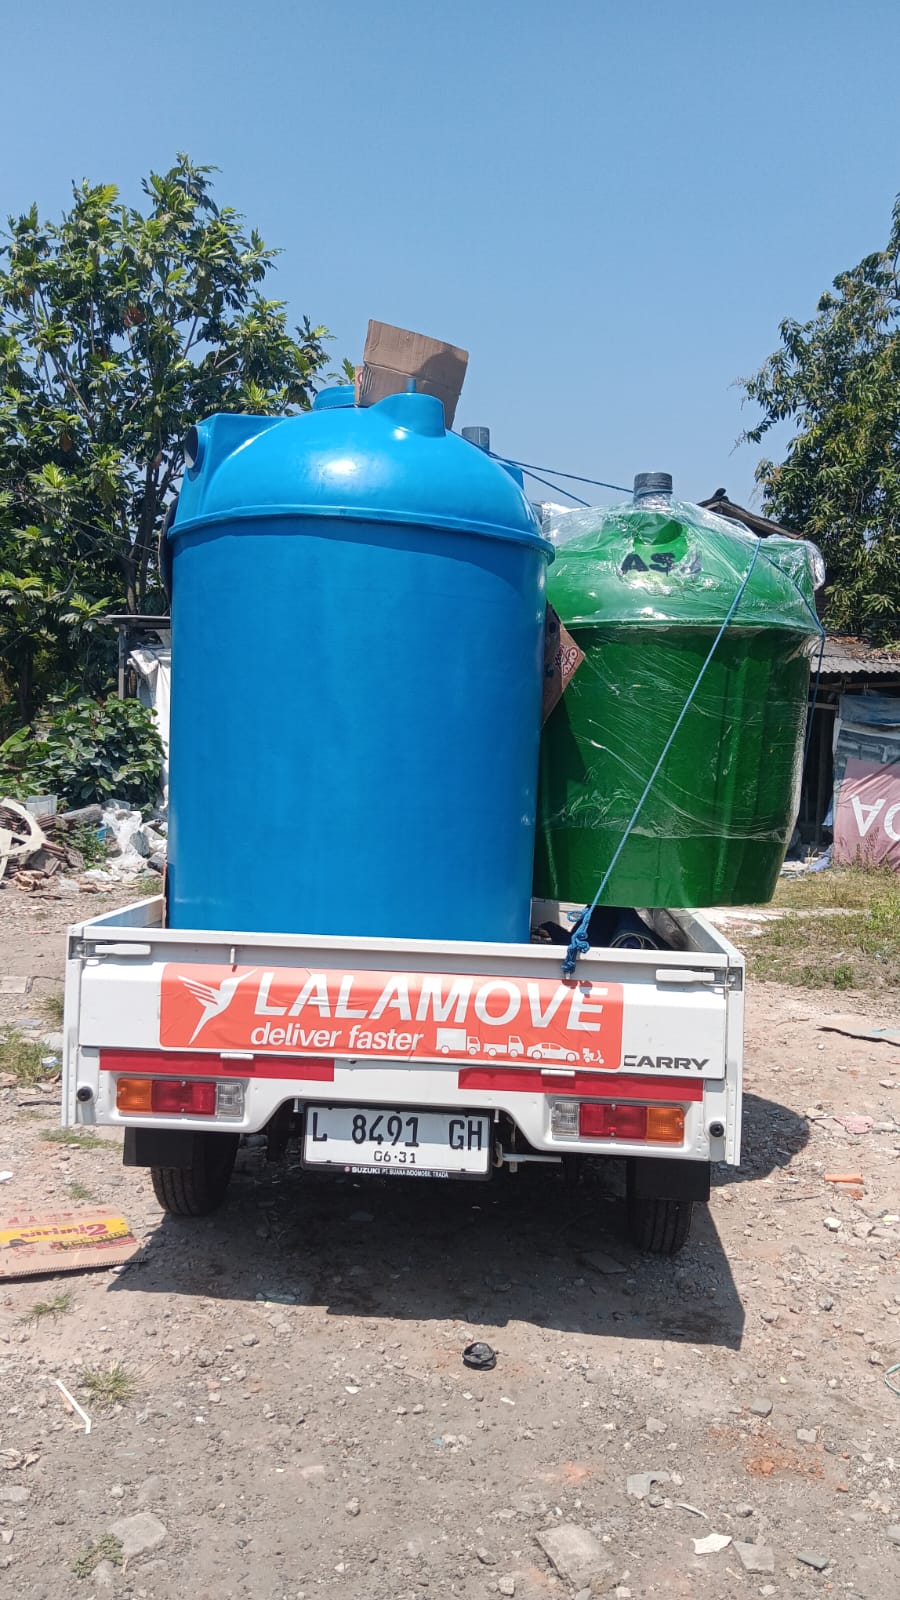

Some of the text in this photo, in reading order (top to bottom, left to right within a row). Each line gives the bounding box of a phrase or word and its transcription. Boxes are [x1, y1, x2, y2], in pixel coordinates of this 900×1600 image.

[252, 971, 609, 1032] LALAMOVE
[250, 1022, 424, 1052] deliver faster
[623, 1054, 710, 1071] CARRY
[312, 1111, 483, 1151] L 8491 GH
[351, 1166, 381, 1175] SUZUKI
